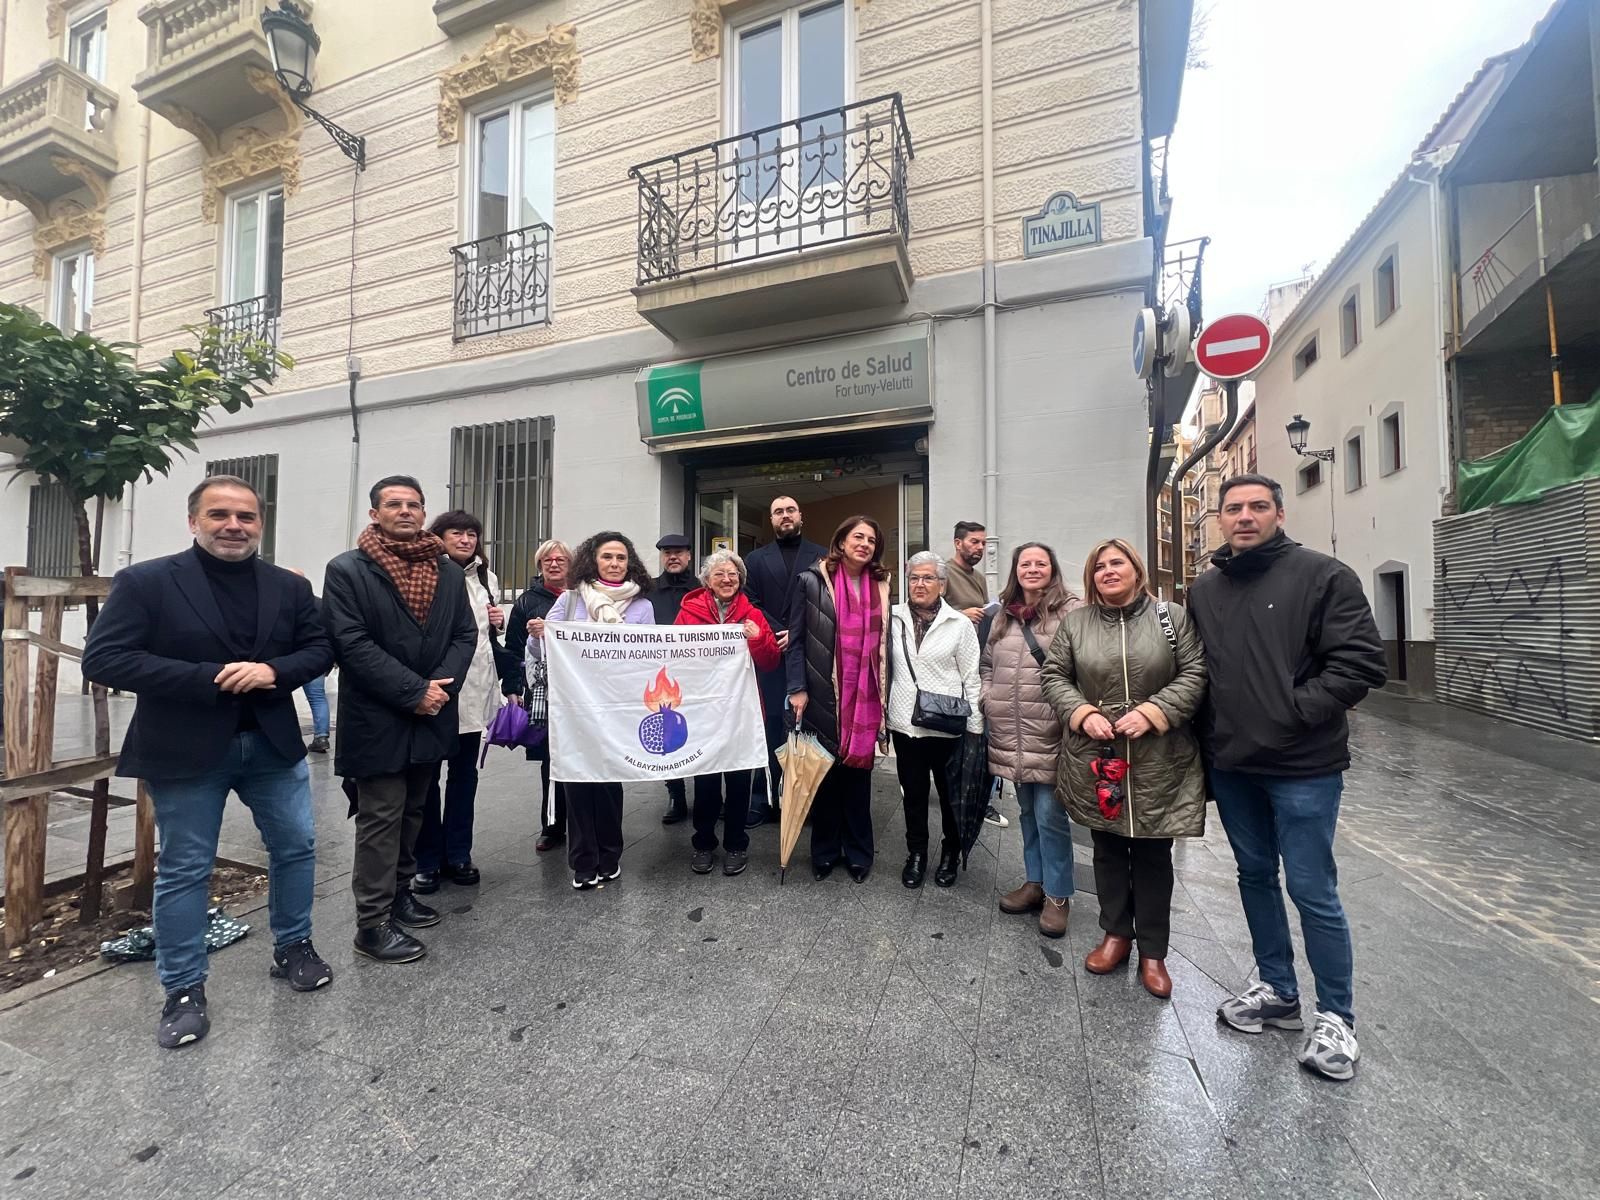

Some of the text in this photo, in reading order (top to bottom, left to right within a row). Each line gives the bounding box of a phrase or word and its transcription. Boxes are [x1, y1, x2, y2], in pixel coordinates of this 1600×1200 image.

[1030, 218, 1093, 245] TINAJILLA
[786, 351, 913, 387] Centro de Salud
[556, 630, 569, 641] EL
[571, 631, 620, 643] ALBAYZÍN
[623, 633, 663, 643] CONTRA
[665, 633, 677, 643] EL
[678, 631, 720, 643] TURISMO
[1160, 616, 1176, 641] LOLA
[581, 646, 736, 660] ALBAYZIN AGAINST MASS TOURISM
